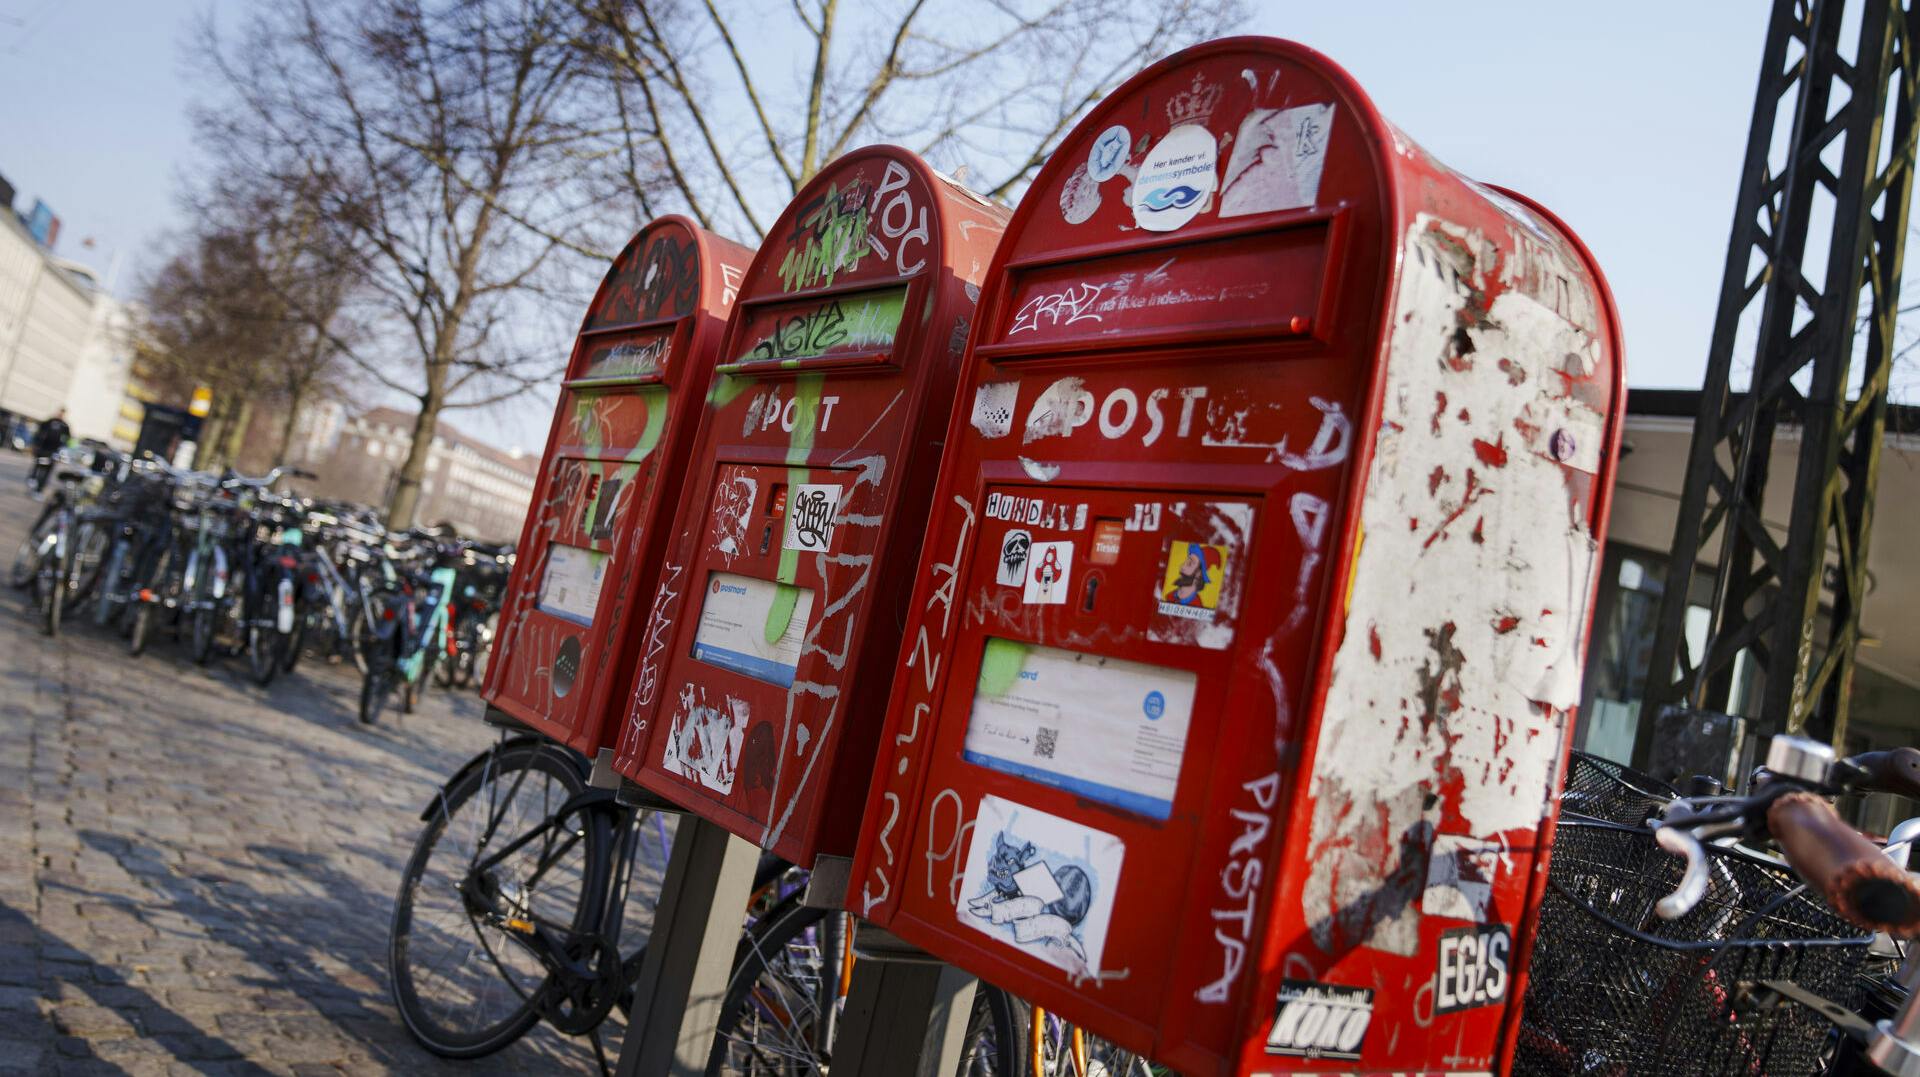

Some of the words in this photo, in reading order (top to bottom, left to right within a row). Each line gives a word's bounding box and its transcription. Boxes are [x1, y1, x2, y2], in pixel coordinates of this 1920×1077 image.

[1153, 160, 1167, 169] Her
[1169, 154, 1195, 167] kender
[1197, 152, 1206, 160] vi
[1060, 387, 1208, 447] POST
[720, 583, 747, 595] postnord
[1194, 771, 1280, 1004] PASTA
[1267, 1001, 1372, 1052] KOKO
